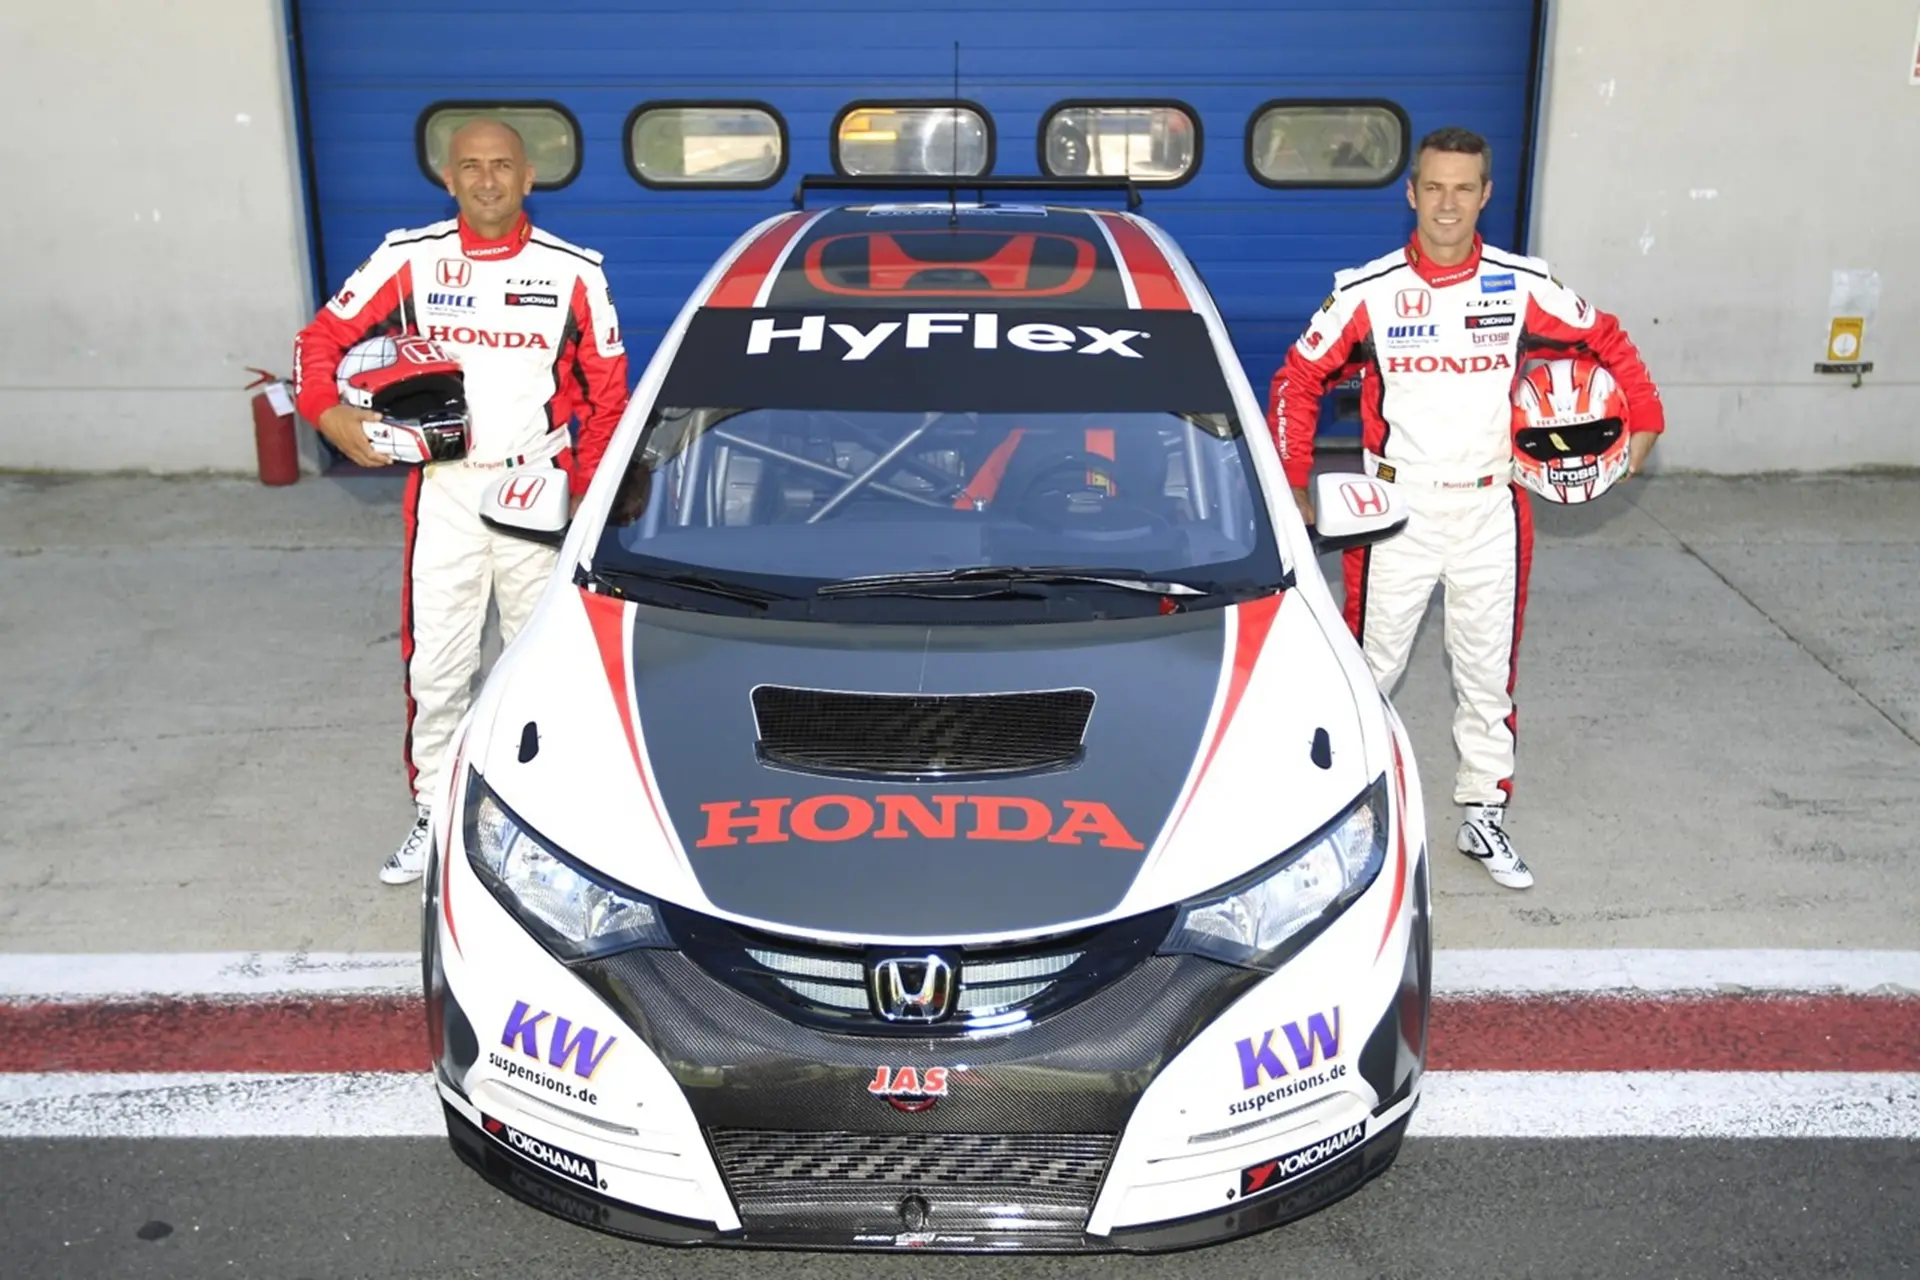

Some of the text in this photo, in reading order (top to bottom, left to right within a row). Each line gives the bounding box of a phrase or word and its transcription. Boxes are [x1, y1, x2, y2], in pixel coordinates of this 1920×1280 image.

[427, 292, 478, 308] WTCC
[427, 325, 550, 350] HONDA
[746, 313, 1144, 360] HyFlex
[1387, 324, 1440, 338] WTCC
[1472, 331, 1510, 344] brose
[1387, 353, 1512, 375] HONDA
[1550, 466, 1598, 481] brose
[696, 795, 1145, 850] HONDA
[502, 999, 618, 1080] KW
[1234, 1005, 1340, 1090] KW
[489, 1052, 598, 1106] suspensions.de
[1228, 1063, 1347, 1116] suspensions.de
[506, 1126, 594, 1182] YOKOHAMA
[1277, 1123, 1363, 1176] YOKOHAMA
